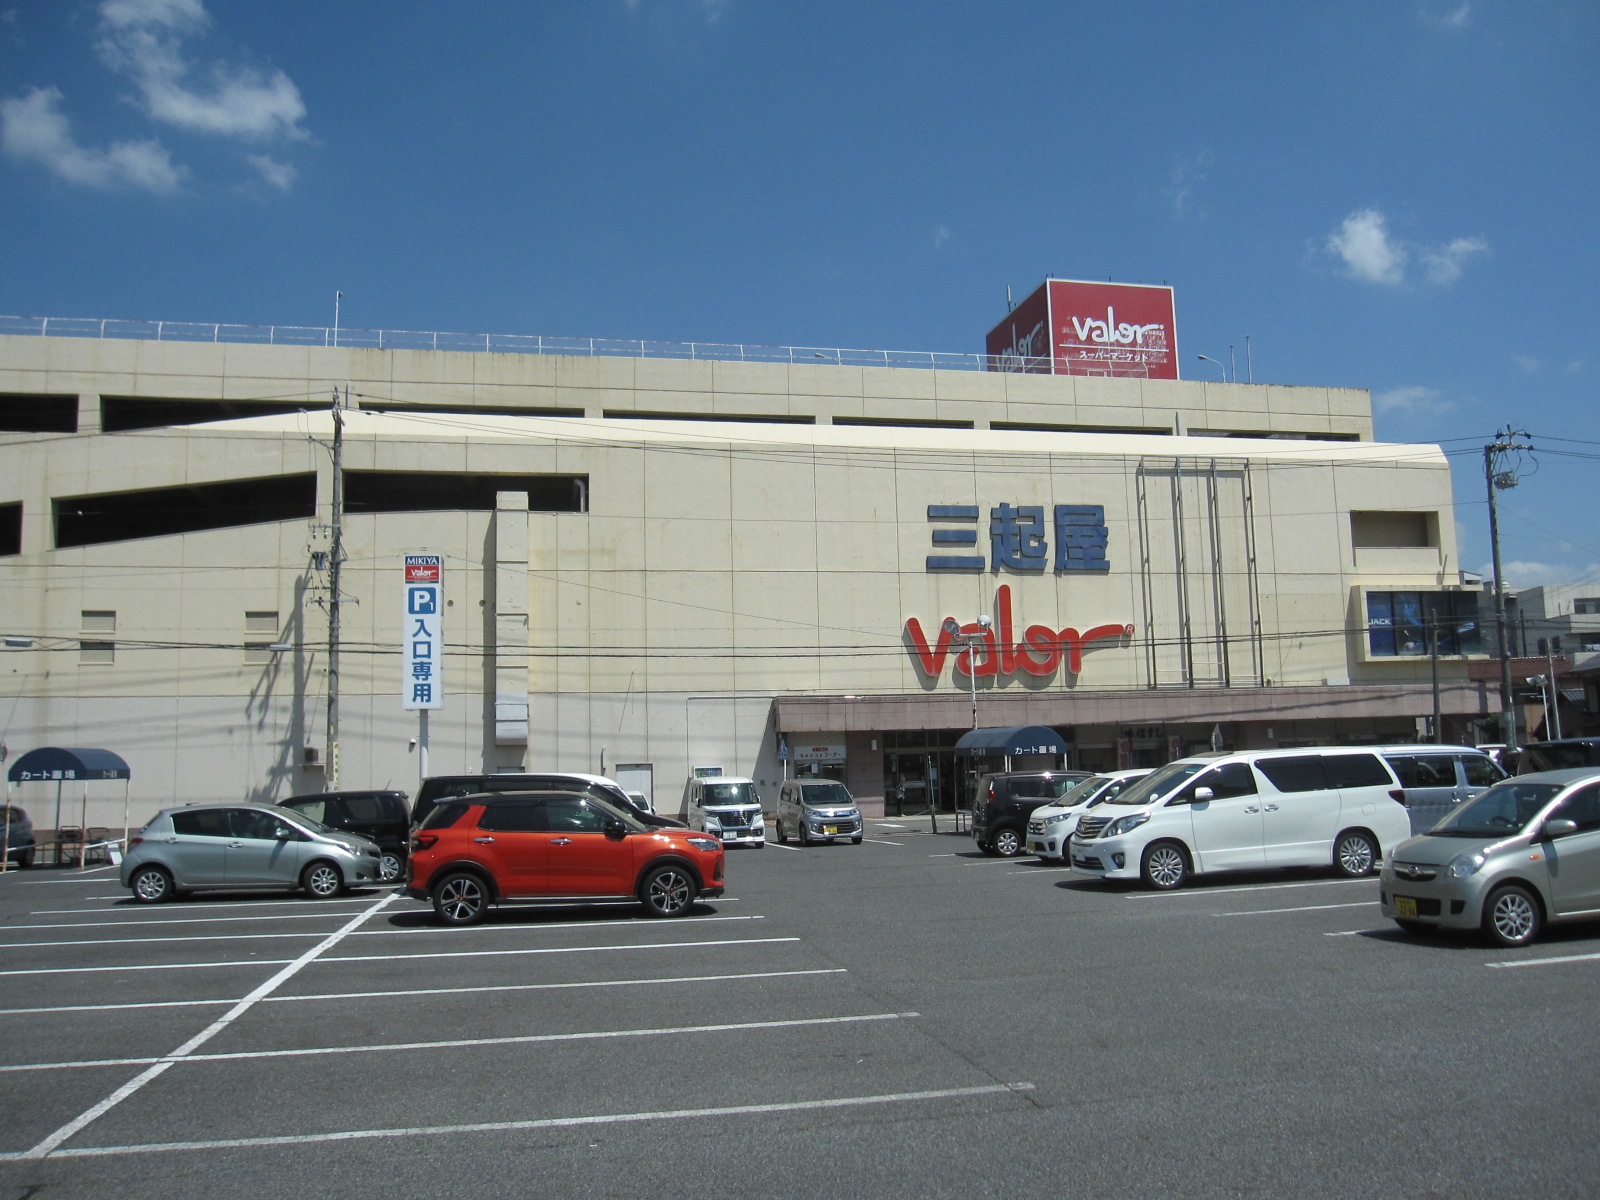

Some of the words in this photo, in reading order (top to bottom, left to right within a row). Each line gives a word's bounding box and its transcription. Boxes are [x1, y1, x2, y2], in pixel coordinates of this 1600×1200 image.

[1072, 306, 1160, 344] valor
[1079, 350, 1149, 363] スーパーマーケット
[926, 502, 1111, 572] 三起屋
[407, 557, 437, 565] MIKIYA
[1368, 618, 1392, 626] JACK
[906, 584, 1124, 677] valor
[411, 618, 433, 703] 入口専用
[1014, 745, 1057, 755] カート置場
[21, 769, 76, 780] カート置場
